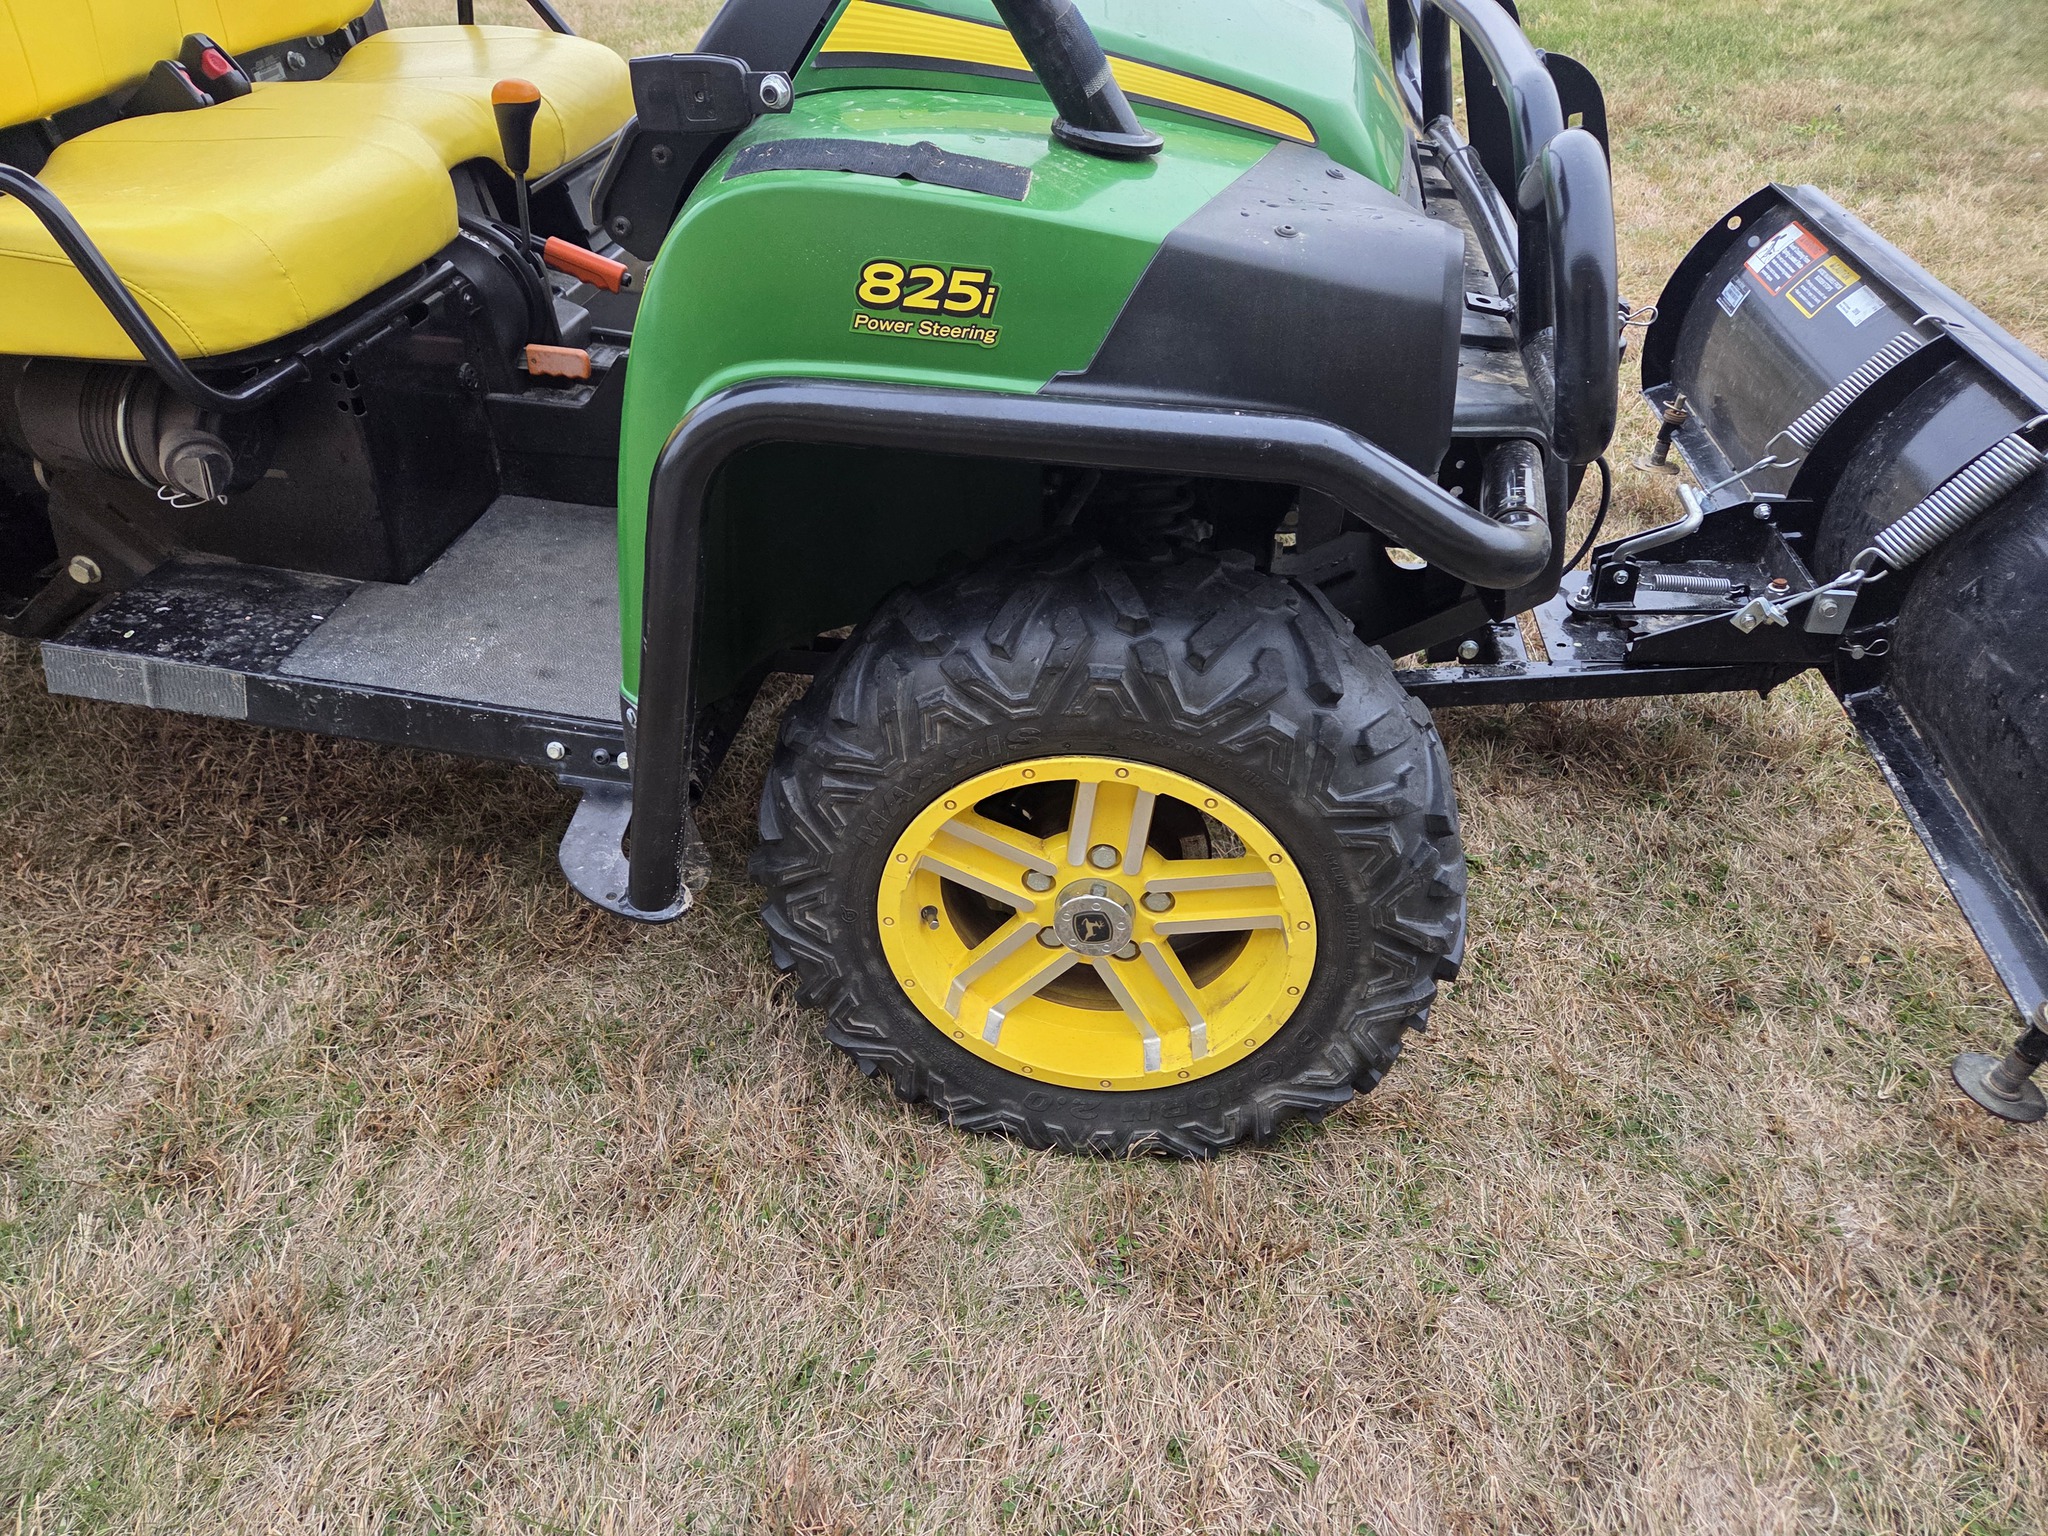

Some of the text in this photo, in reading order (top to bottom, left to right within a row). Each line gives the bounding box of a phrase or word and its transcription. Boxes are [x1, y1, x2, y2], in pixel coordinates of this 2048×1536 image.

[857, 261, 997, 316] 825i
[854, 315, 998, 345] Power Steering
[855, 726, 1042, 847] MAXXIS
